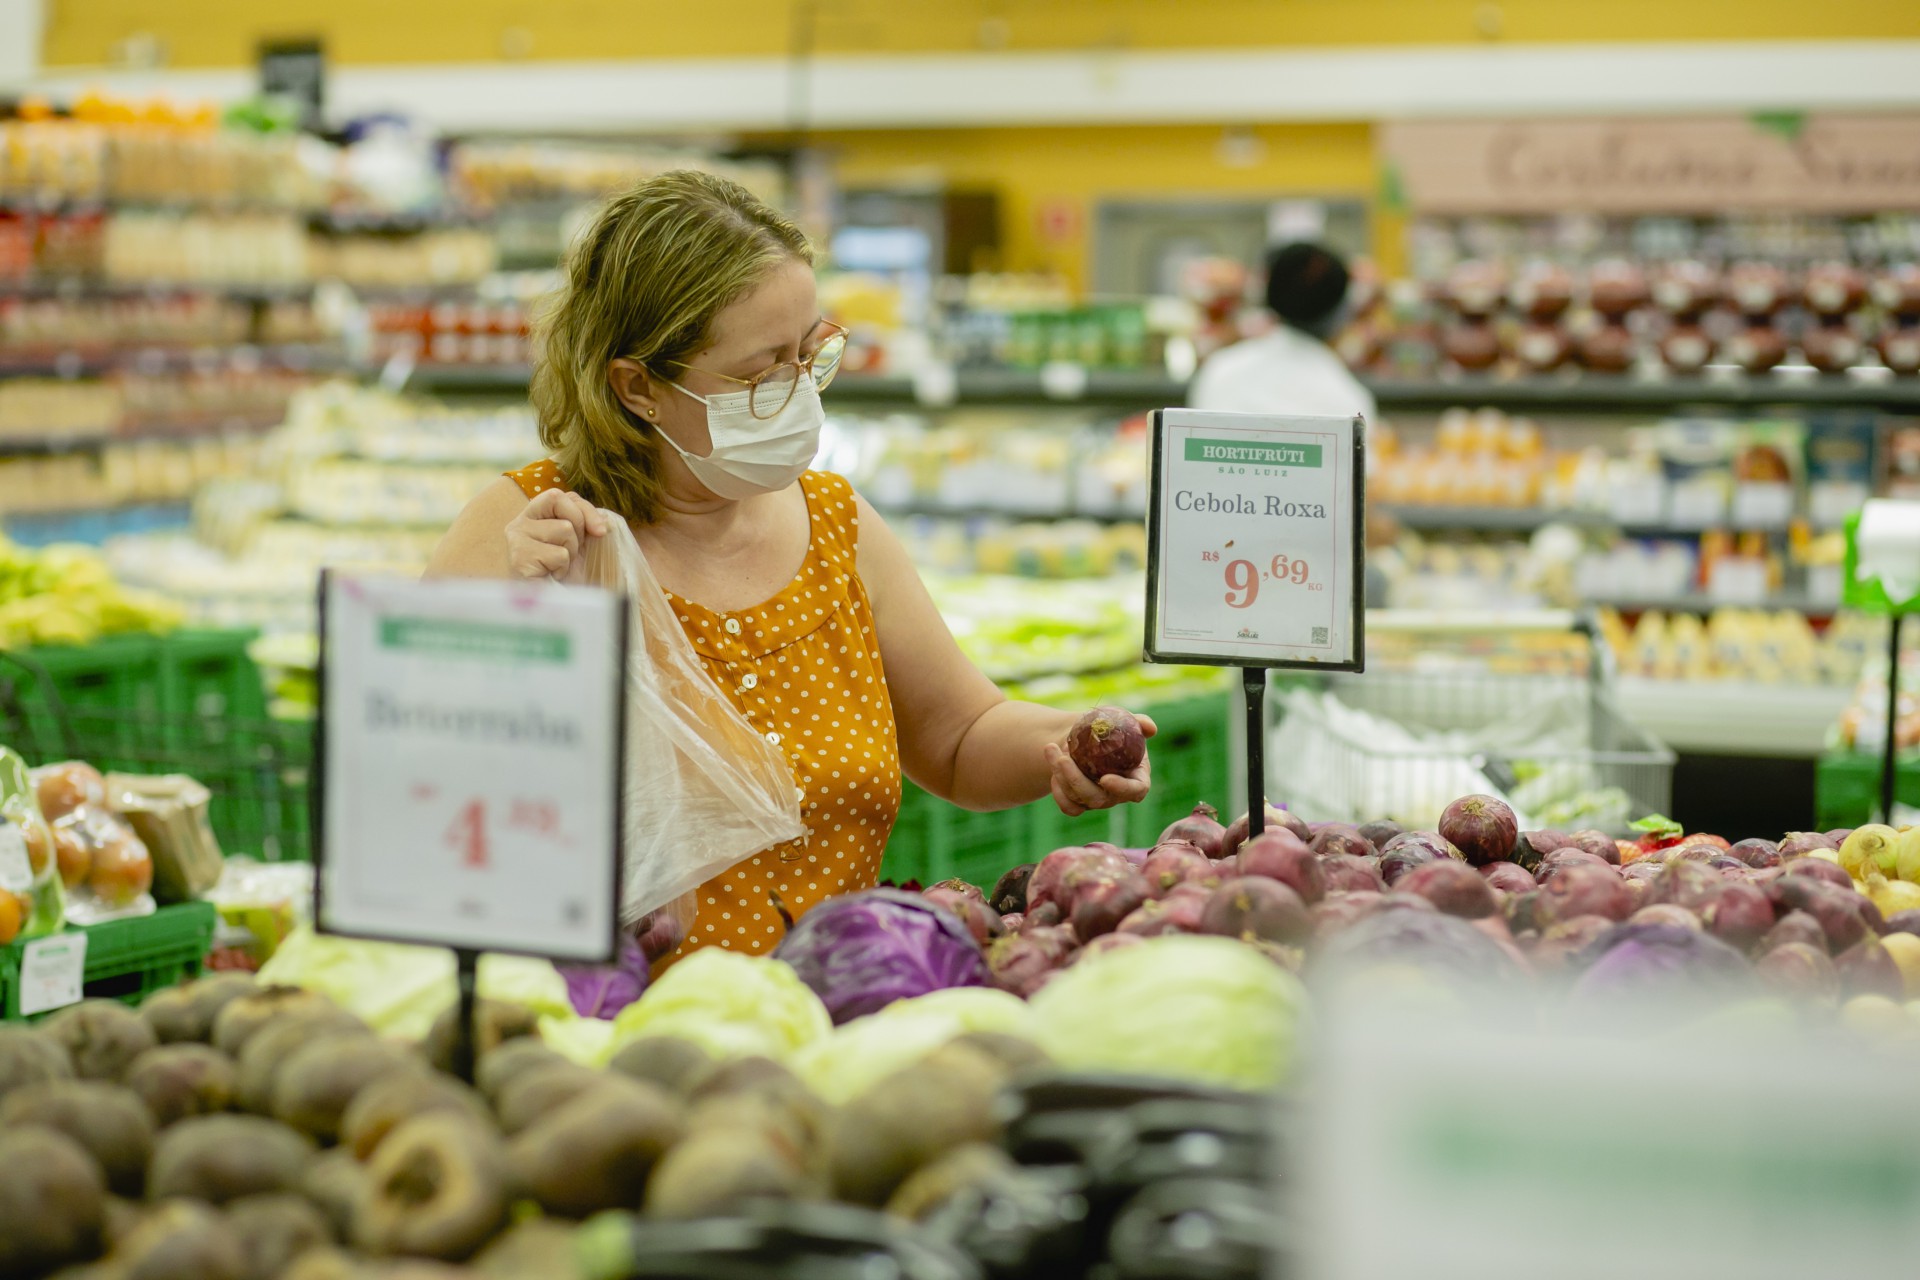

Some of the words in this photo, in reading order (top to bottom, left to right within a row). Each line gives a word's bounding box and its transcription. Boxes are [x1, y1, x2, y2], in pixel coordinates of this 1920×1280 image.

[1202, 445, 1306, 463] HORTIFRÚTI
[1218, 465, 1245, 475] SÃO
[1254, 468, 1288, 477] LUIZ
[1175, 490, 1256, 515] Cebola
[1263, 495, 1327, 519] Roxa
[1202, 551, 1220, 562] R$
[1307, 583, 1323, 591] KG
